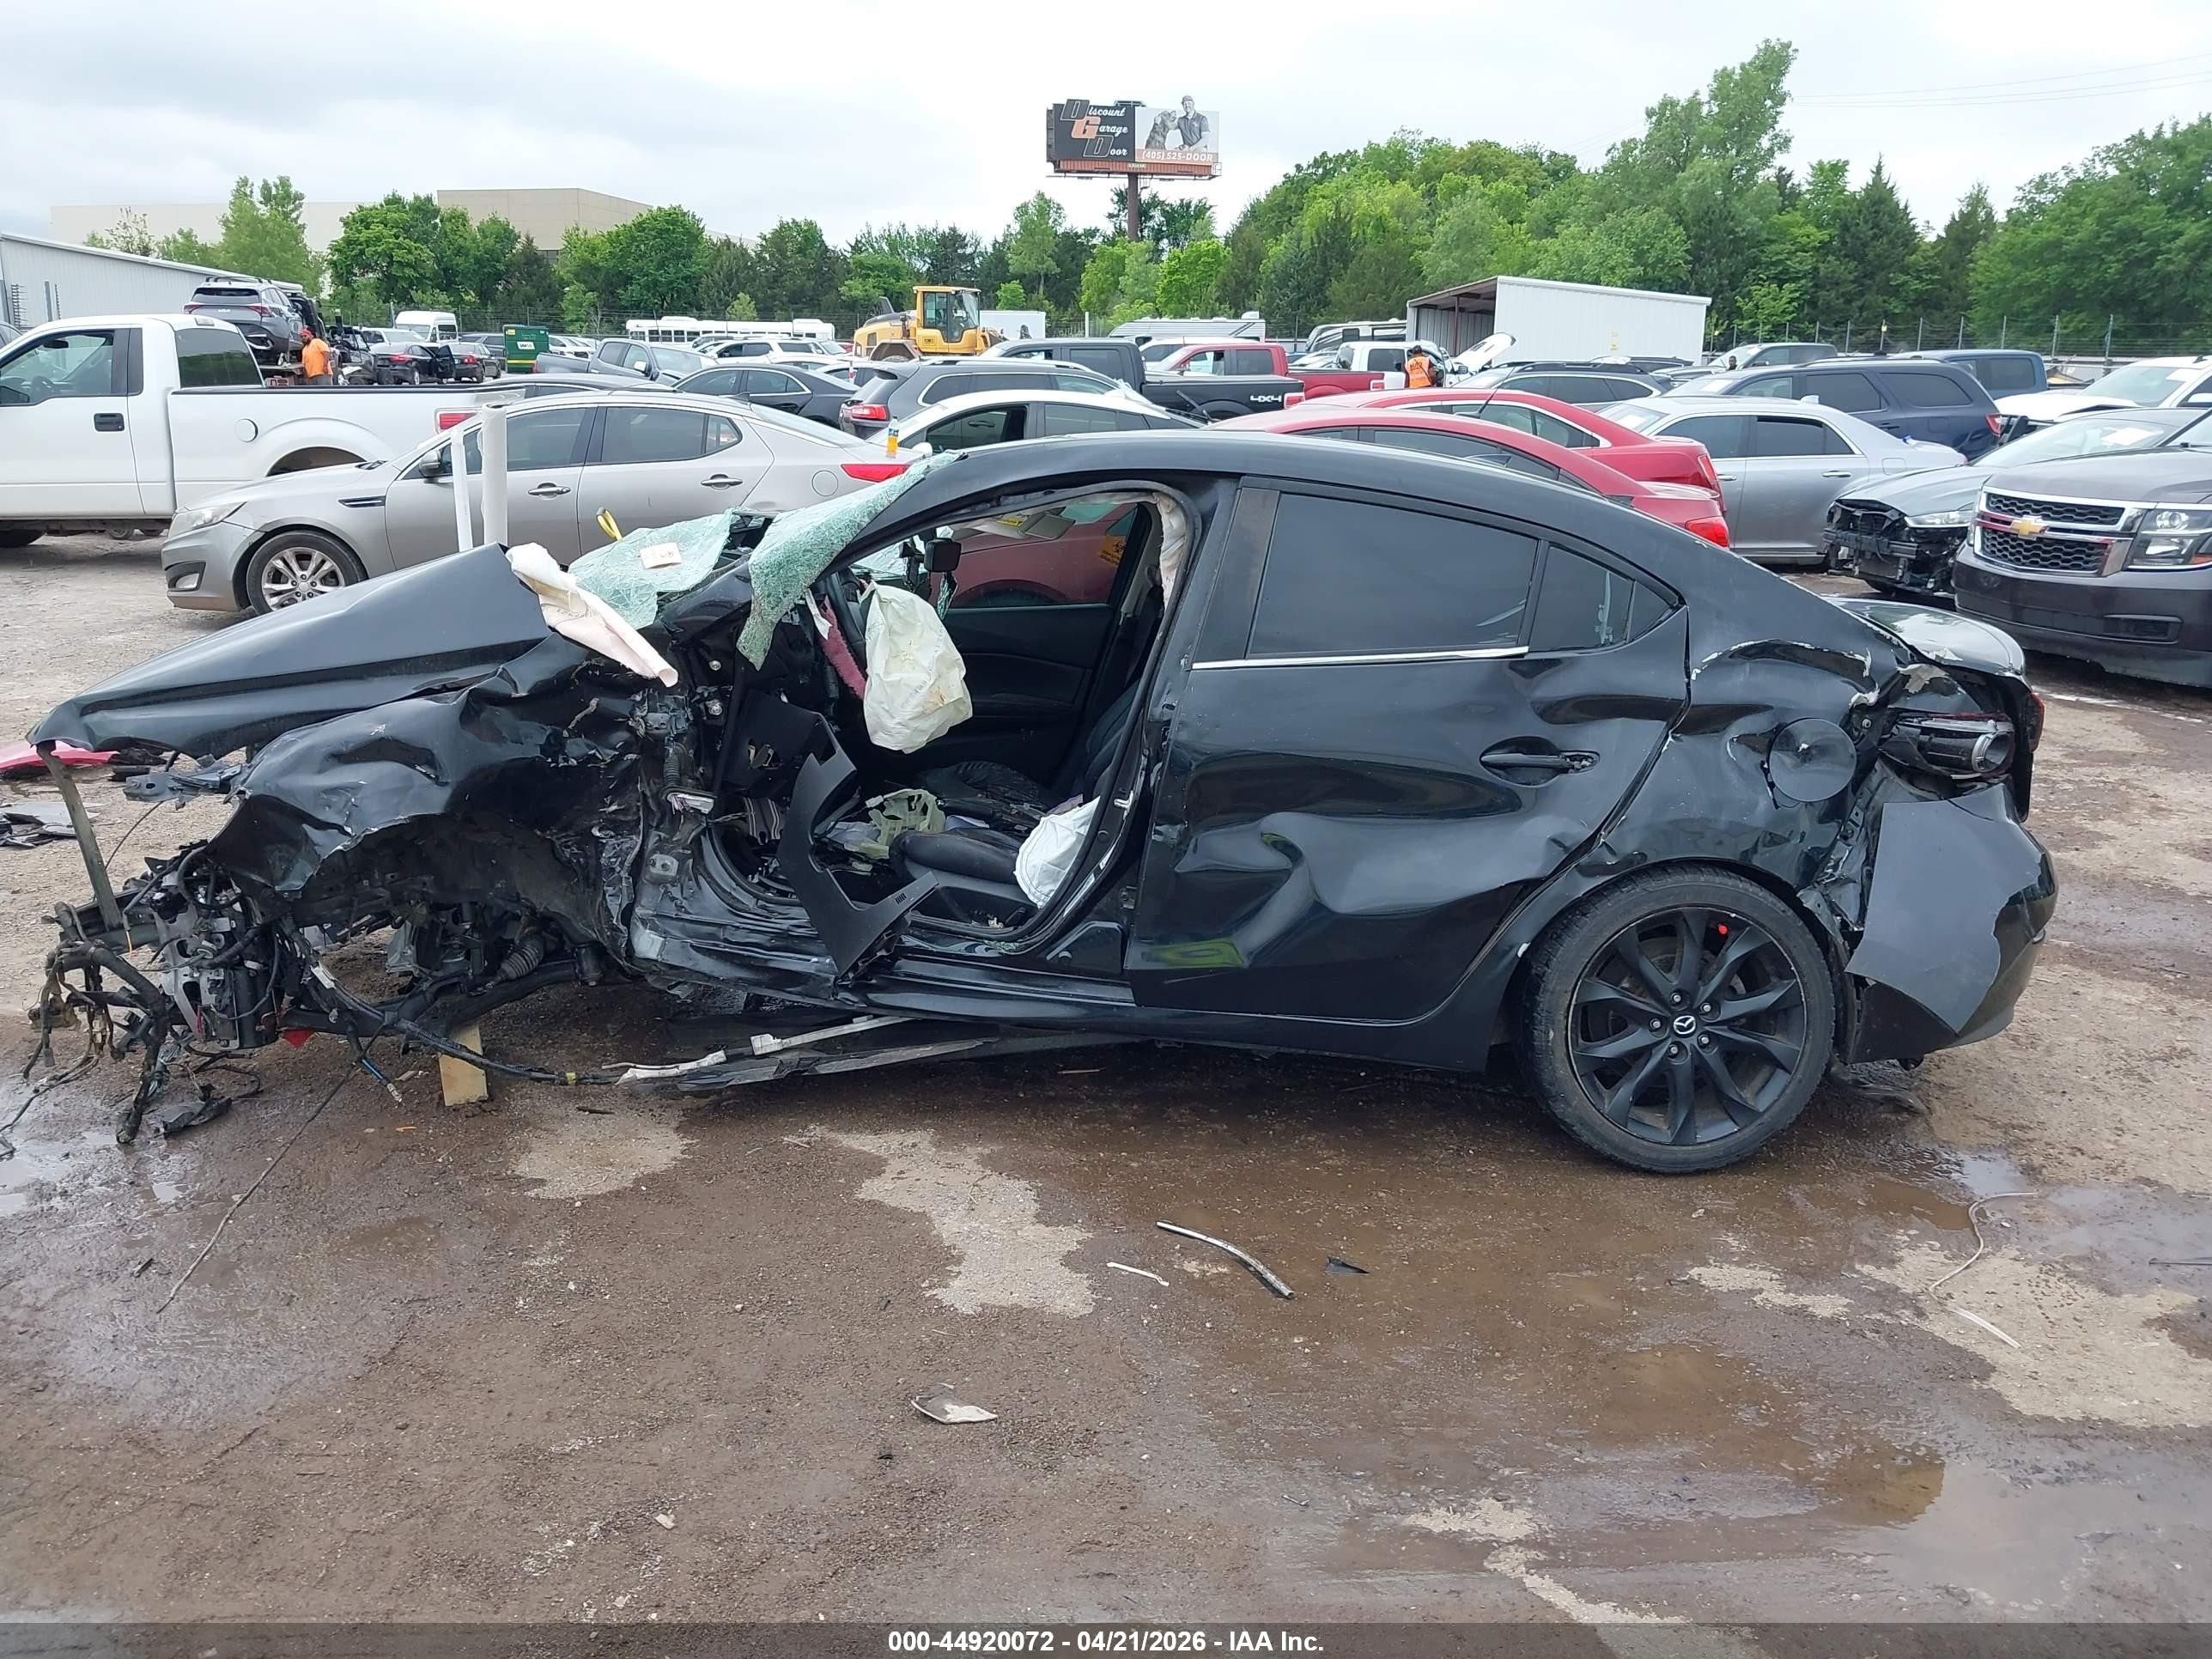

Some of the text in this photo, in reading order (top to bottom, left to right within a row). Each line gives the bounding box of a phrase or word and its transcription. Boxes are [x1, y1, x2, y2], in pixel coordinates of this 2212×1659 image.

[1060, 99, 1125, 121] Discount
[1071, 116, 1128, 139] Garage
[1083, 135, 1128, 157] Door
[1142, 150, 1213, 161] (405) 525-DOOR
